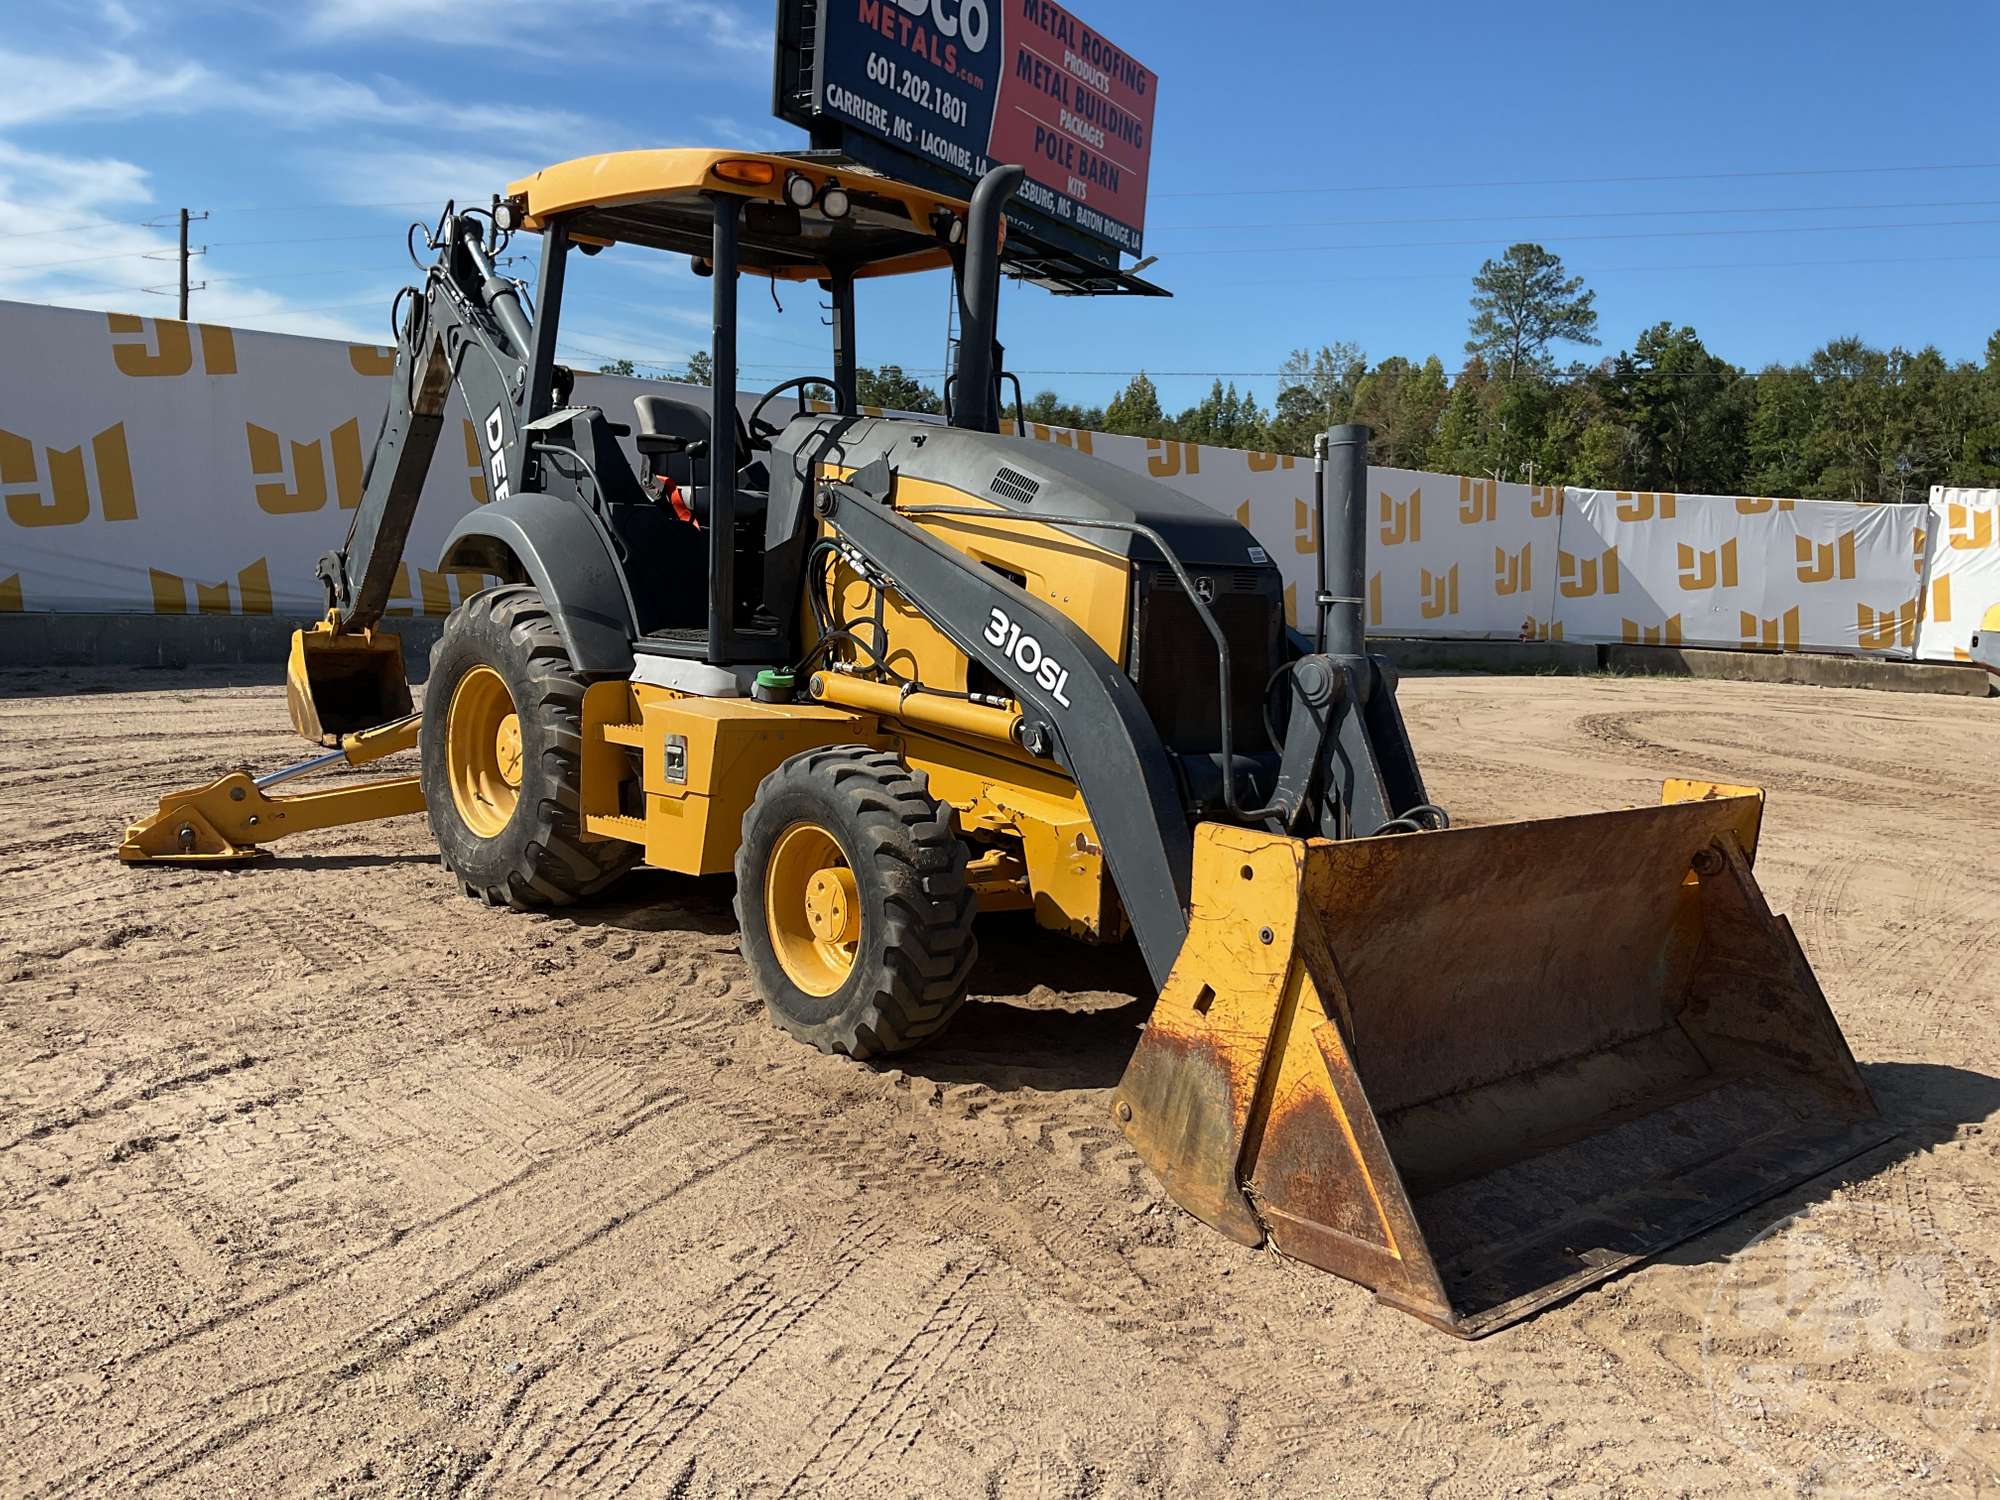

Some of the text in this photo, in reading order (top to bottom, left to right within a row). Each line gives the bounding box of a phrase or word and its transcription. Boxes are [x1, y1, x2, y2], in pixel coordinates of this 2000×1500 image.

[1023, 0, 1146, 95] METAL ROOFING
[1064, 50, 1109, 94] PRODUCTS
[867, 52, 967, 127] 601.202.1801
[1016, 50, 1143, 149] METAL BUILDING
[1034, 126, 1120, 193] POLE BARN
[1060, 109, 1105, 149] PACKAGES
[827, 84, 890, 136] CARRIERE,
[893, 116, 912, 143] MS
[921, 130, 973, 176] LACOMBE,
[975, 156, 987, 177] LA
[1057, 196, 1071, 218] MS
[1076, 206, 1103, 233] BATON
[1103, 217, 1132, 247] ROUGE,
[1131, 229, 1141, 250] LA
[1067, 176, 1087, 200] KITS
[983, 605, 1071, 711] 310SL
